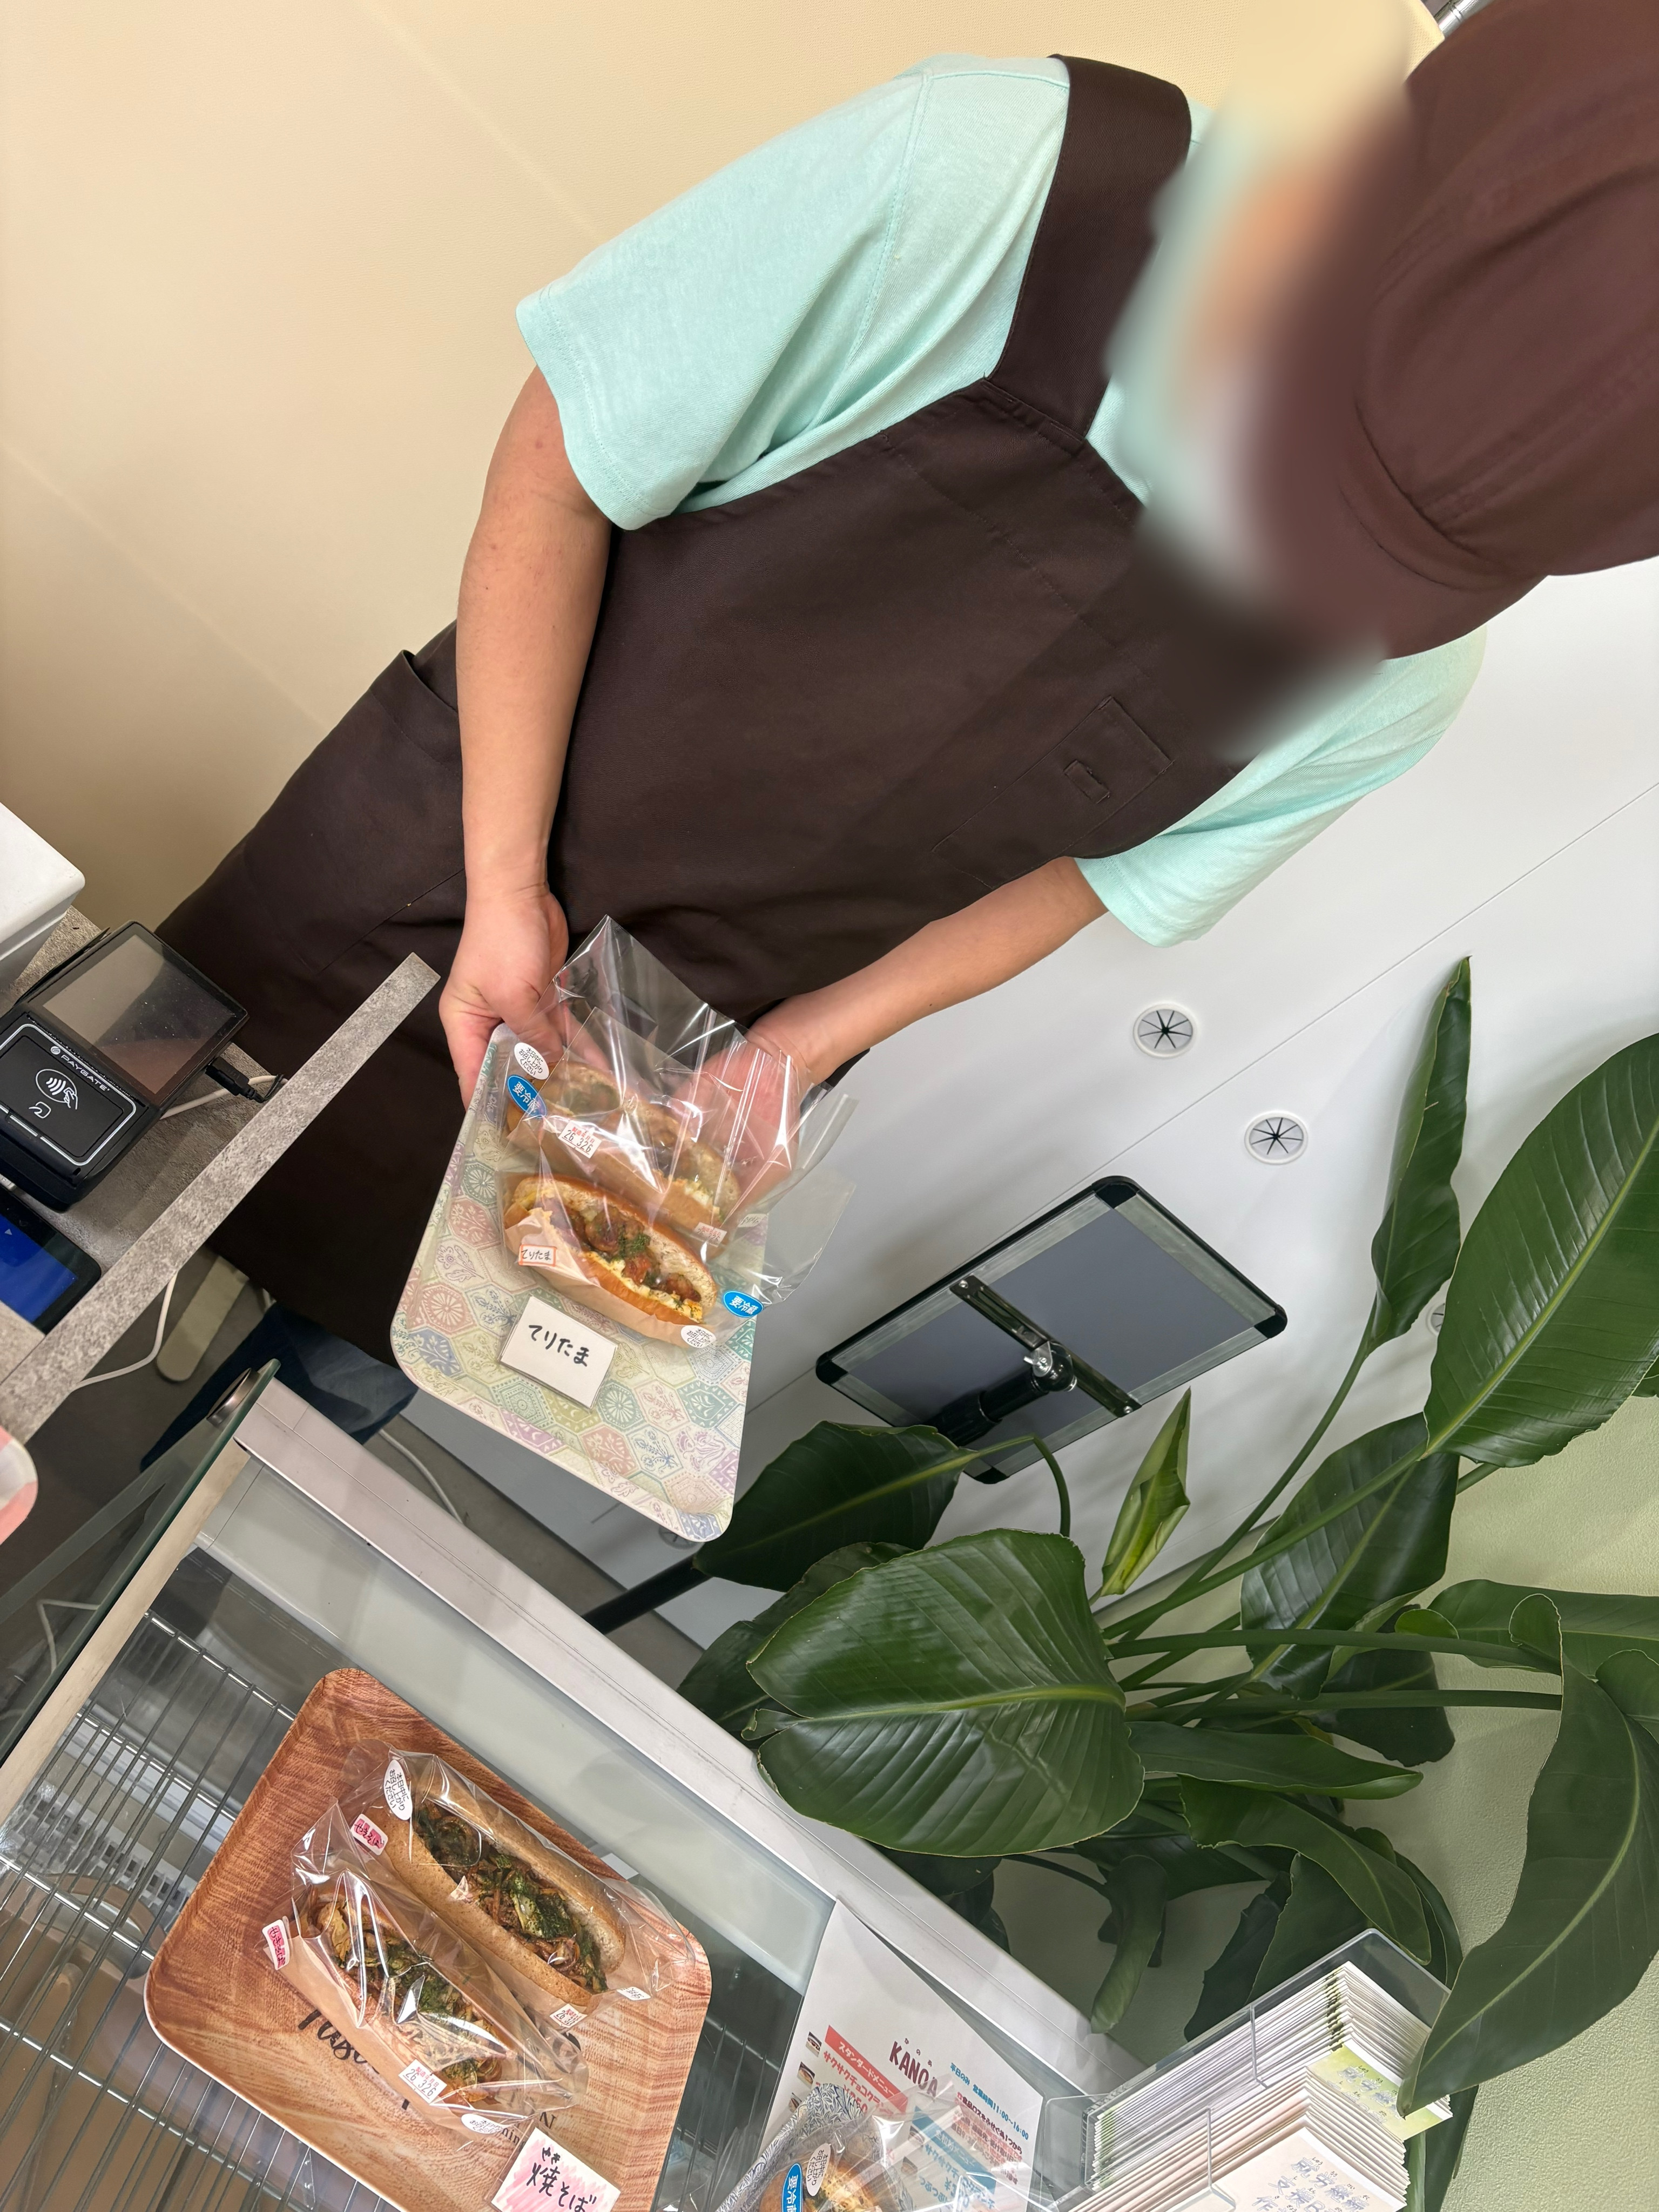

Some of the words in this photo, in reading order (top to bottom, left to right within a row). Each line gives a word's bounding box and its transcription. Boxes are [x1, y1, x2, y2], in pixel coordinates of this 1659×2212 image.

[519, 1049, 543, 1073] お召し上がり
[520, 1058, 536, 1076] ください
[526, 1048, 543, 1065] 本日中に
[61, 1054, 107, 1091] PAYGATE
[521, 1249, 551, 1261] てりたま
[729, 1295, 759, 1316] 要冷蔵
[528, 1324, 590, 1367] てりたま
[385, 1780, 397, 1809] ください
[389, 1769, 406, 1811] お召し上がり
[396, 1772, 409, 1803] 本日中に
[269, 1926, 286, 1966] やきそば
[415, 2067, 440, 2088] 製造年月日
[838, 2041, 895, 2096] スタンダードメニュー
[889, 2041, 938, 2098] KANOA
[950, 2062, 970, 2086] 平日のみ
[807, 2156, 816, 2182] ください
[812, 2149, 824, 2186] お召し上がり
[818, 2154, 828, 2179] 本日中に
[1290, 2157, 1370, 2210] 就労継続
